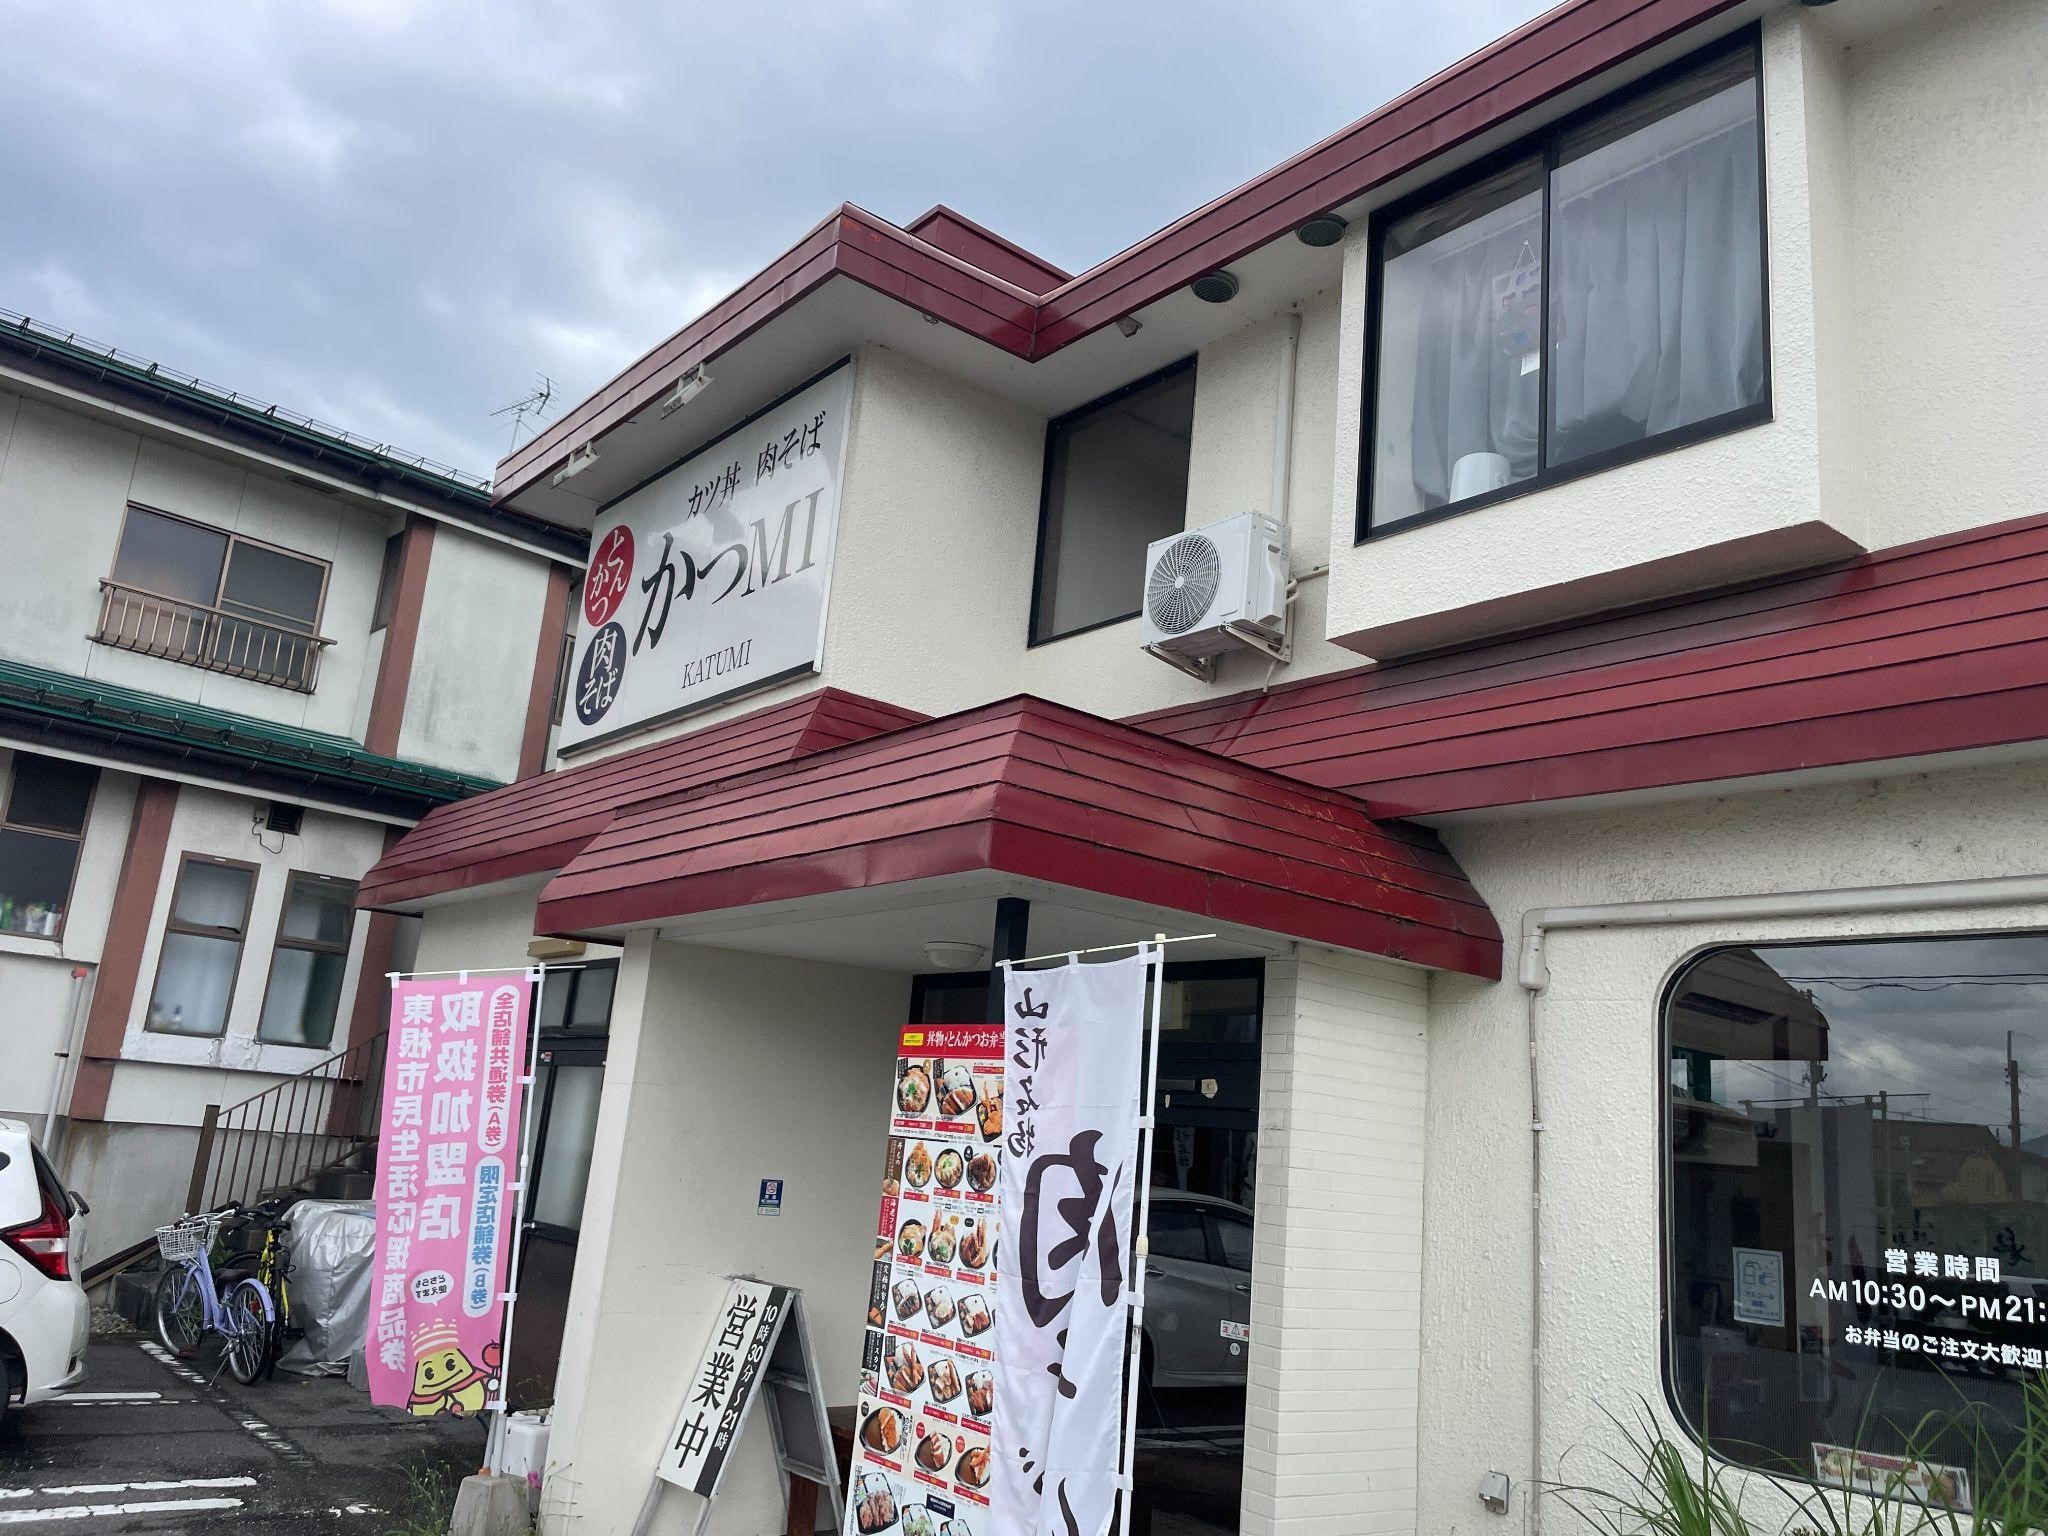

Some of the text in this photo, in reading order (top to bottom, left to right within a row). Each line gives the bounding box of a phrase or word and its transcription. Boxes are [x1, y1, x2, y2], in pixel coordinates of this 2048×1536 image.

[686, 410, 826, 520] カツ丼 肉そば
[633, 488, 825, 656] かつMI
[578, 628, 619, 716] 肉そば
[681, 639, 753, 690] KATUMI
[1885, 1249, 2000, 1283] 営業時間
[674, 1292, 757, 1469] 営業中
